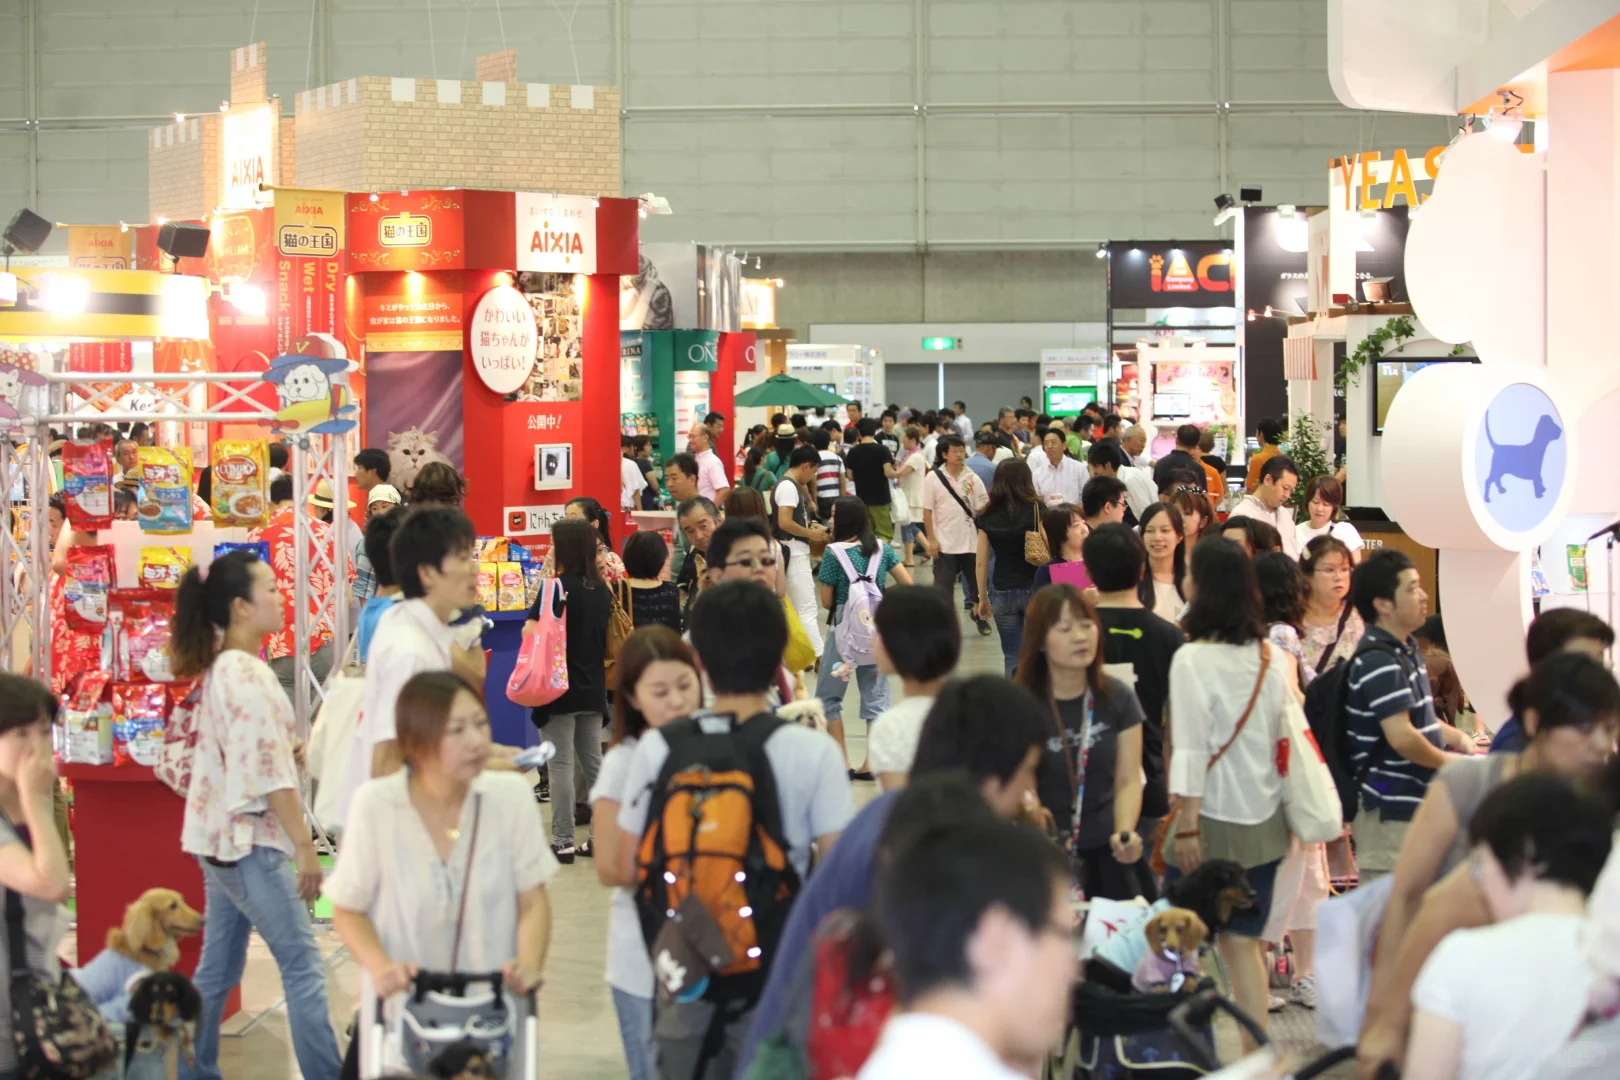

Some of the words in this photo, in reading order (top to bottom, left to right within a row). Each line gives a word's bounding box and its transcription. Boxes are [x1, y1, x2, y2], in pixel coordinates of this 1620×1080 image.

[384, 222, 427, 239] 猫の王国
[283, 232, 334, 249] 猫の王国
[303, 261, 315, 293] Wet
[325, 262, 338, 292] Dry
[279, 261, 291, 313] Snack
[484, 308, 526, 324] かわいい
[480, 331, 530, 348] 猫ちゃんが
